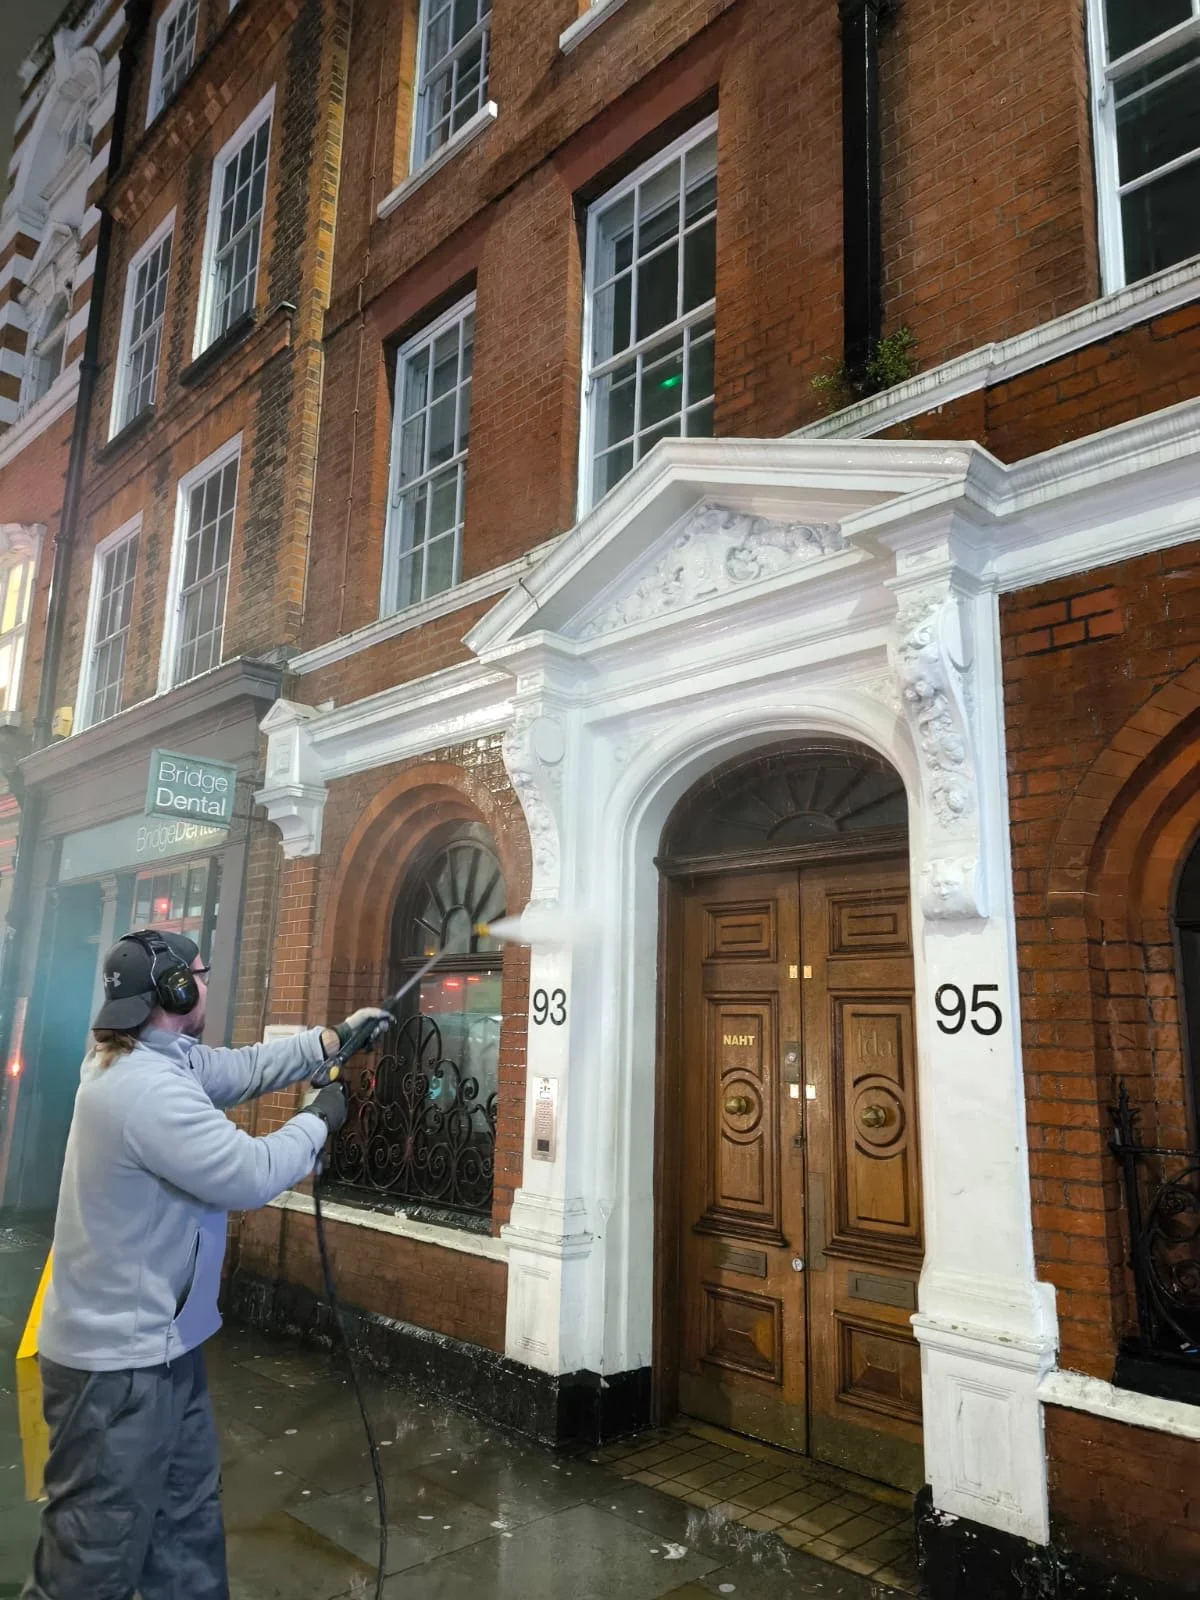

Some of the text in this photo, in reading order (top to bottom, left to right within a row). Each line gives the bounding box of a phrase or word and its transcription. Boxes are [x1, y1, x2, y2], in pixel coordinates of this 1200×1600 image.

[158, 761, 229, 794] Bridge
[155, 787, 227, 816] Dental
[136, 821, 220, 853] BridgeDenta
[532, 988, 567, 1026] 93
[935, 983, 1003, 1036] 95
[723, 1034, 756, 1046] NAHT
